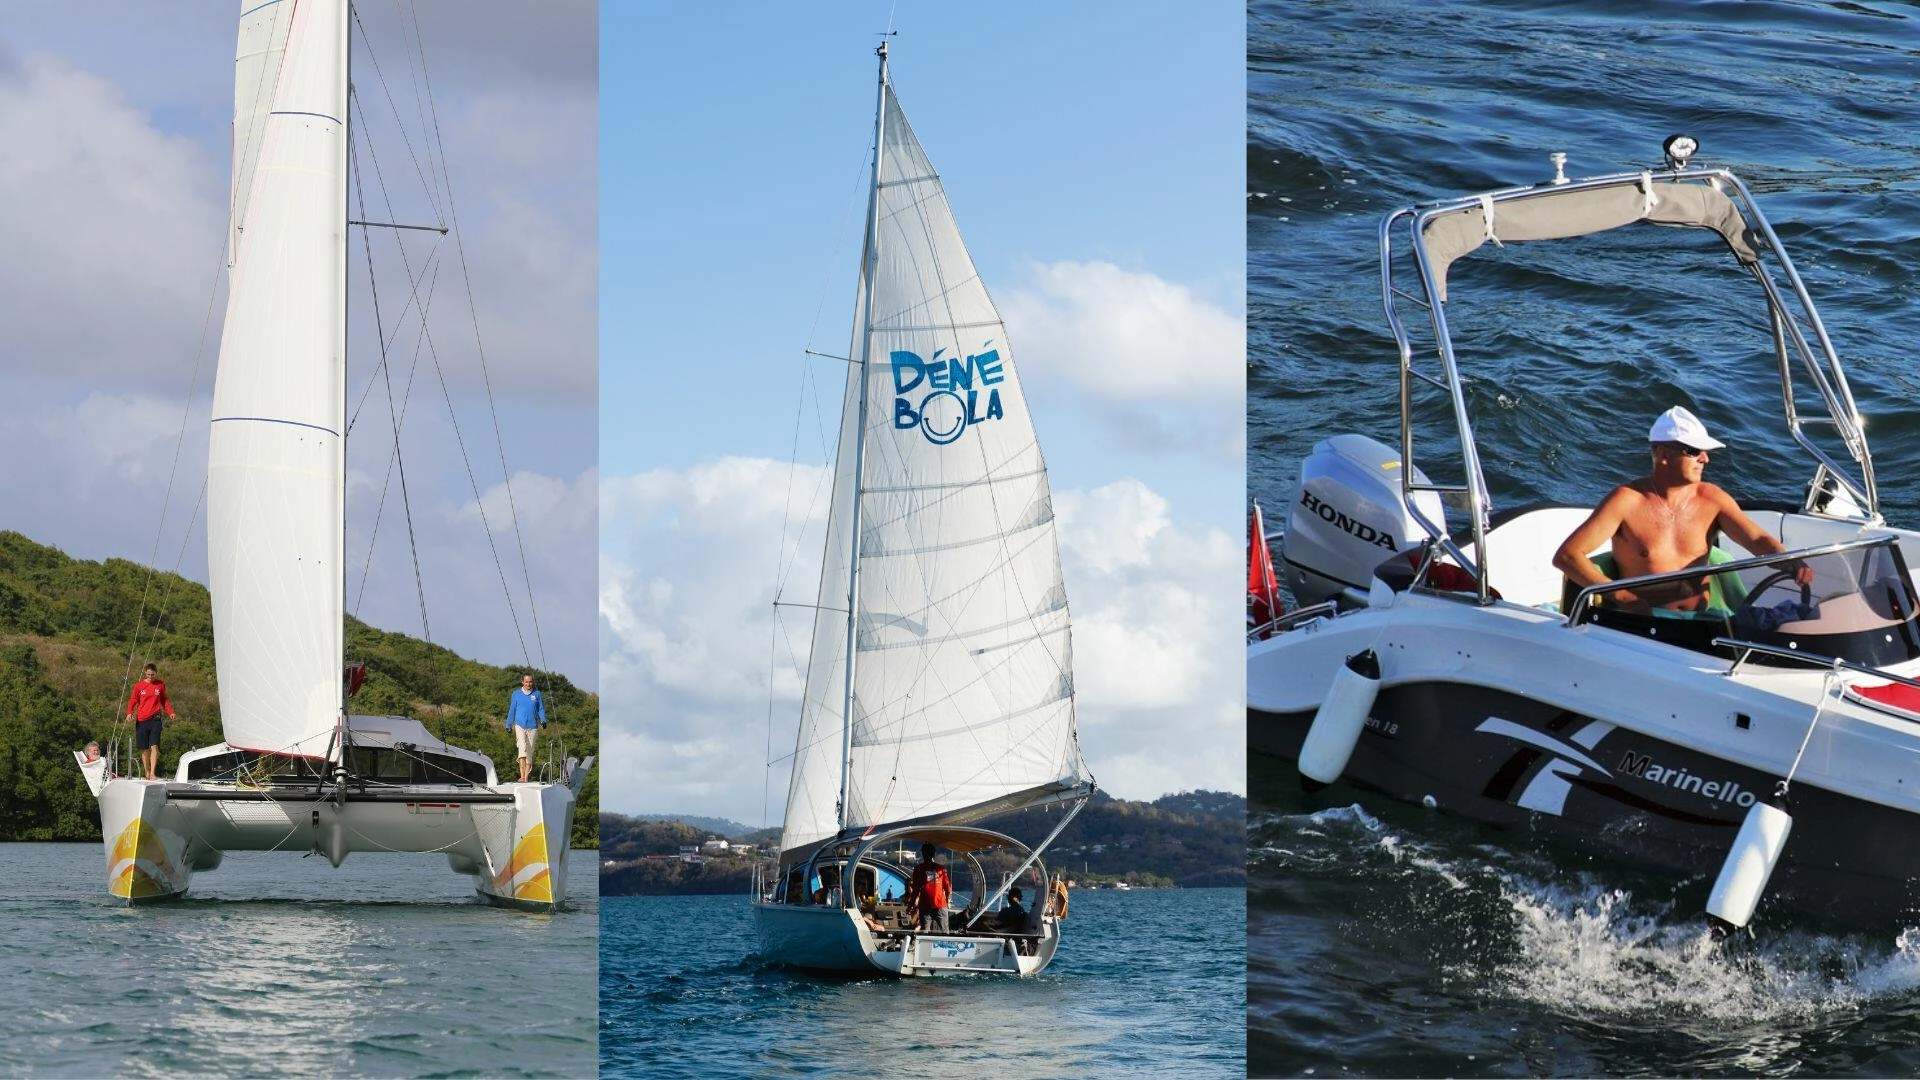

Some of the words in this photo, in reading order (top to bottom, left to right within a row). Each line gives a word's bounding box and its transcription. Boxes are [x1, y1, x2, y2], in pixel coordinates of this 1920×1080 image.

[889, 339, 1004, 396] DÉNÉ
[894, 388, 1004, 445] BOLA
[1300, 489, 1398, 552] HONDA
[1364, 716, 1380, 728] en
[1383, 721, 1399, 735] 18
[1616, 750, 1756, 808] Marinello
